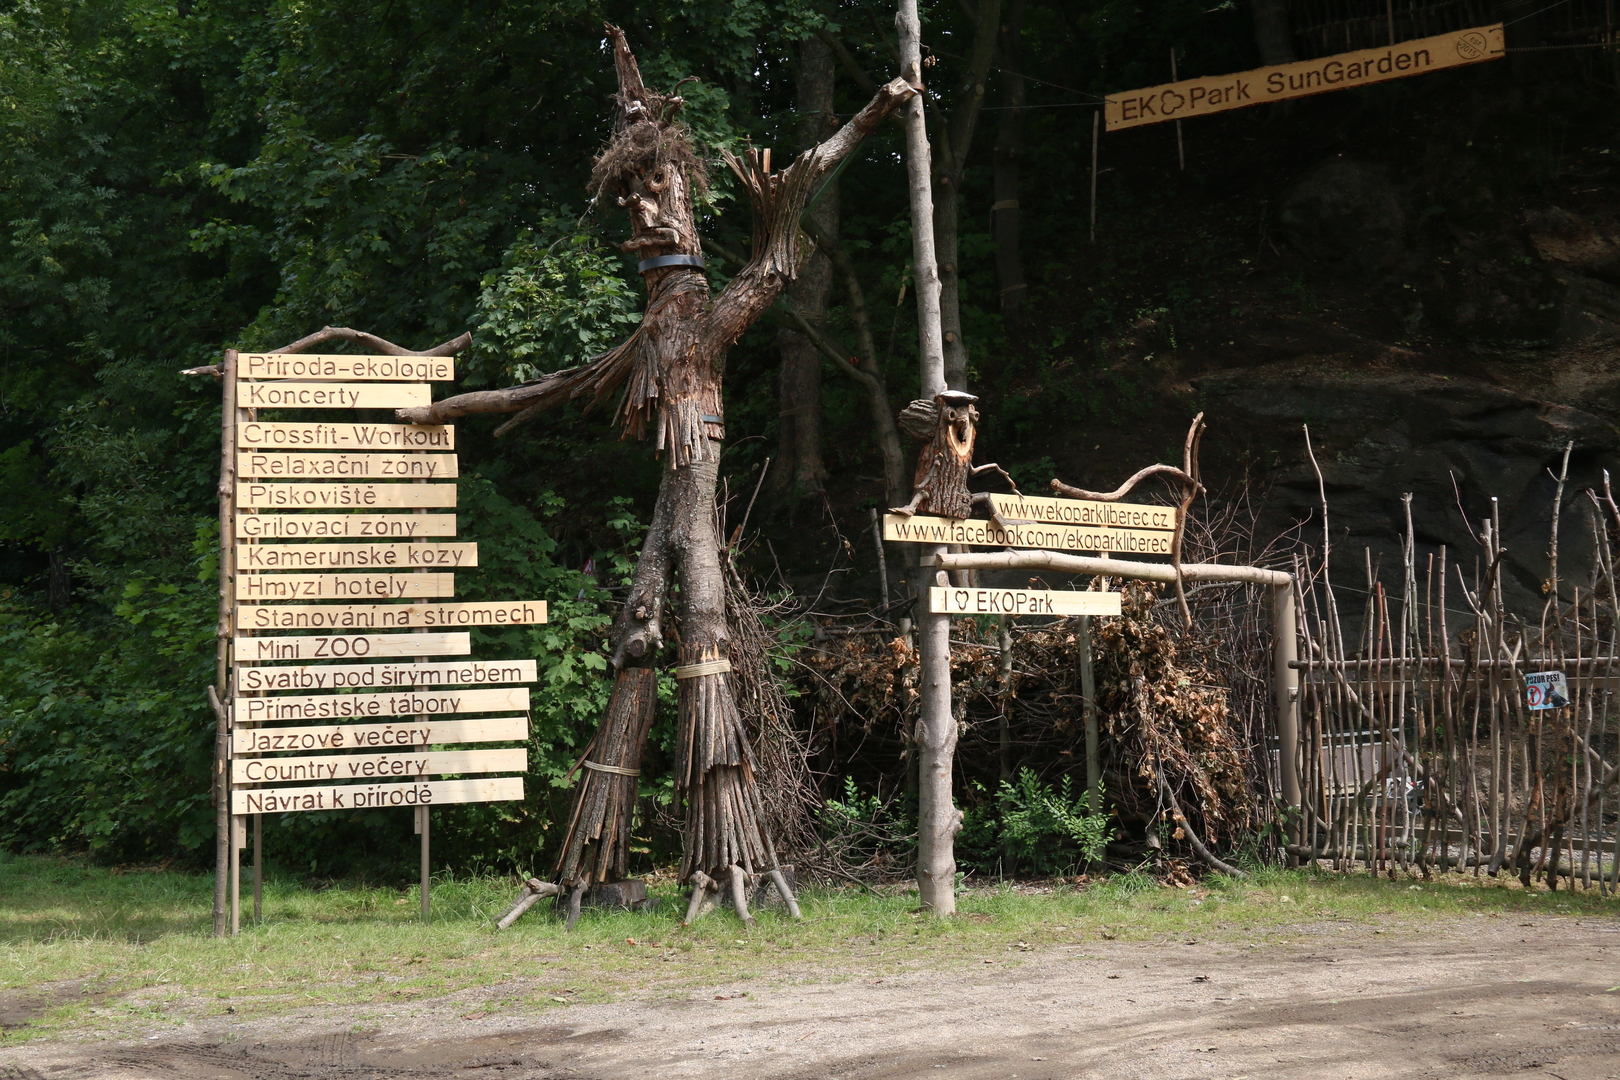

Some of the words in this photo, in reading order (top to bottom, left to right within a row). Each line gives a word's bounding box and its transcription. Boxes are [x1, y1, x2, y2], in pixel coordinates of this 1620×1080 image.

[1266, 49, 1431, 94] SunGarden
[248, 355, 448, 380] Příroda-ekologie
[250, 385, 360, 409] Koncerty
[244, 424, 450, 446] Crossfit-Workout
[251, 455, 370, 475] Relaxační
[381, 455, 437, 477] zóny
[250, 485, 377, 505] Pískoviště
[243, 515, 349, 537] Grilovací
[360, 515, 416, 537] zóny
[999, 501, 1168, 527] www.ekoparkliberec.cz
[895, 520, 1168, 552] www.facebook.com/ekoparkliberec
[249, 544, 397, 566] Kamerunské
[408, 545, 463, 567] kozy
[248, 575, 323, 599] Hmyzí
[334, 576, 408, 598] hotely
[976, 591, 1054, 613] EKOPark
[255, 605, 376, 628] Stanování
[382, 610, 410, 626] na
[424, 604, 536, 625] stromech
[257, 640, 300, 659] Mini
[314, 636, 370, 657] ZOO
[247, 667, 327, 689] Svatby
[333, 666, 374, 688] pod
[447, 664, 522, 683] nebem
[1526, 675, 1546, 684] POZOR
[1546, 673, 1560, 682] PES!
[248, 695, 380, 719] Příměstské
[390, 693, 461, 714] tábory
[247, 727, 344, 751] Jazzové
[354, 725, 431, 745] večery
[246, 760, 338, 781] Country
[349, 756, 427, 776] večery
[246, 790, 323, 812] Návrat
[333, 789, 345, 808] k
[354, 784, 433, 808] přírodě
